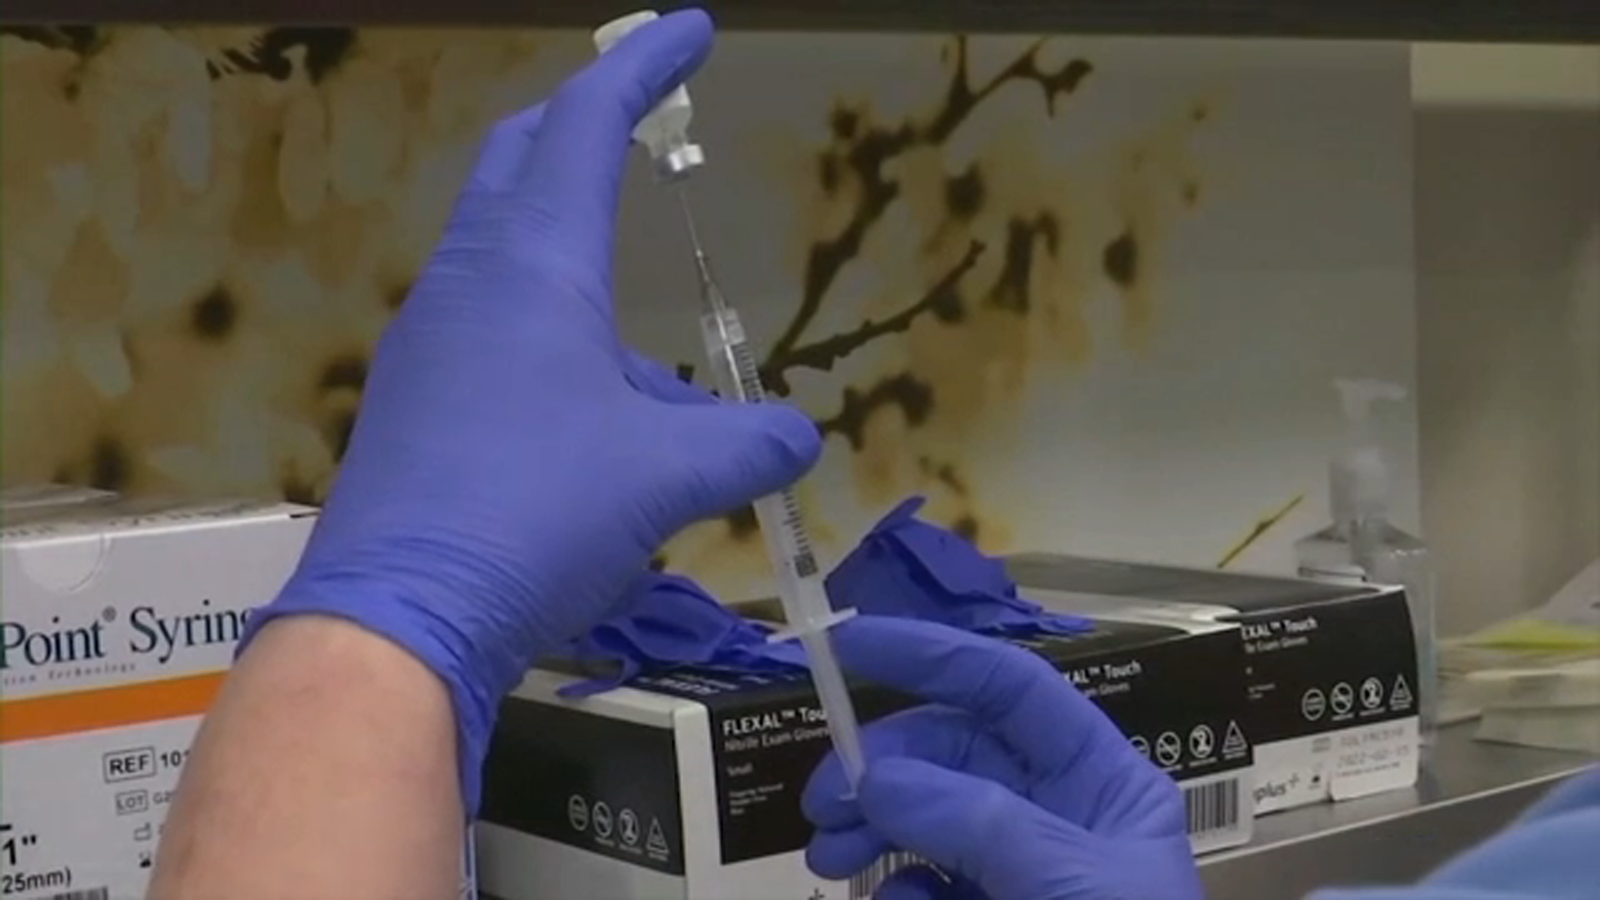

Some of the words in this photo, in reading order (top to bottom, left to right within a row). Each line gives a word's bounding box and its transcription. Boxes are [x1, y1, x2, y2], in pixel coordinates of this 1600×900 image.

[1283, 616, 1318, 633] Touch
[1103, 660, 1141, 679] Touch
[109, 753, 150, 776] REF
